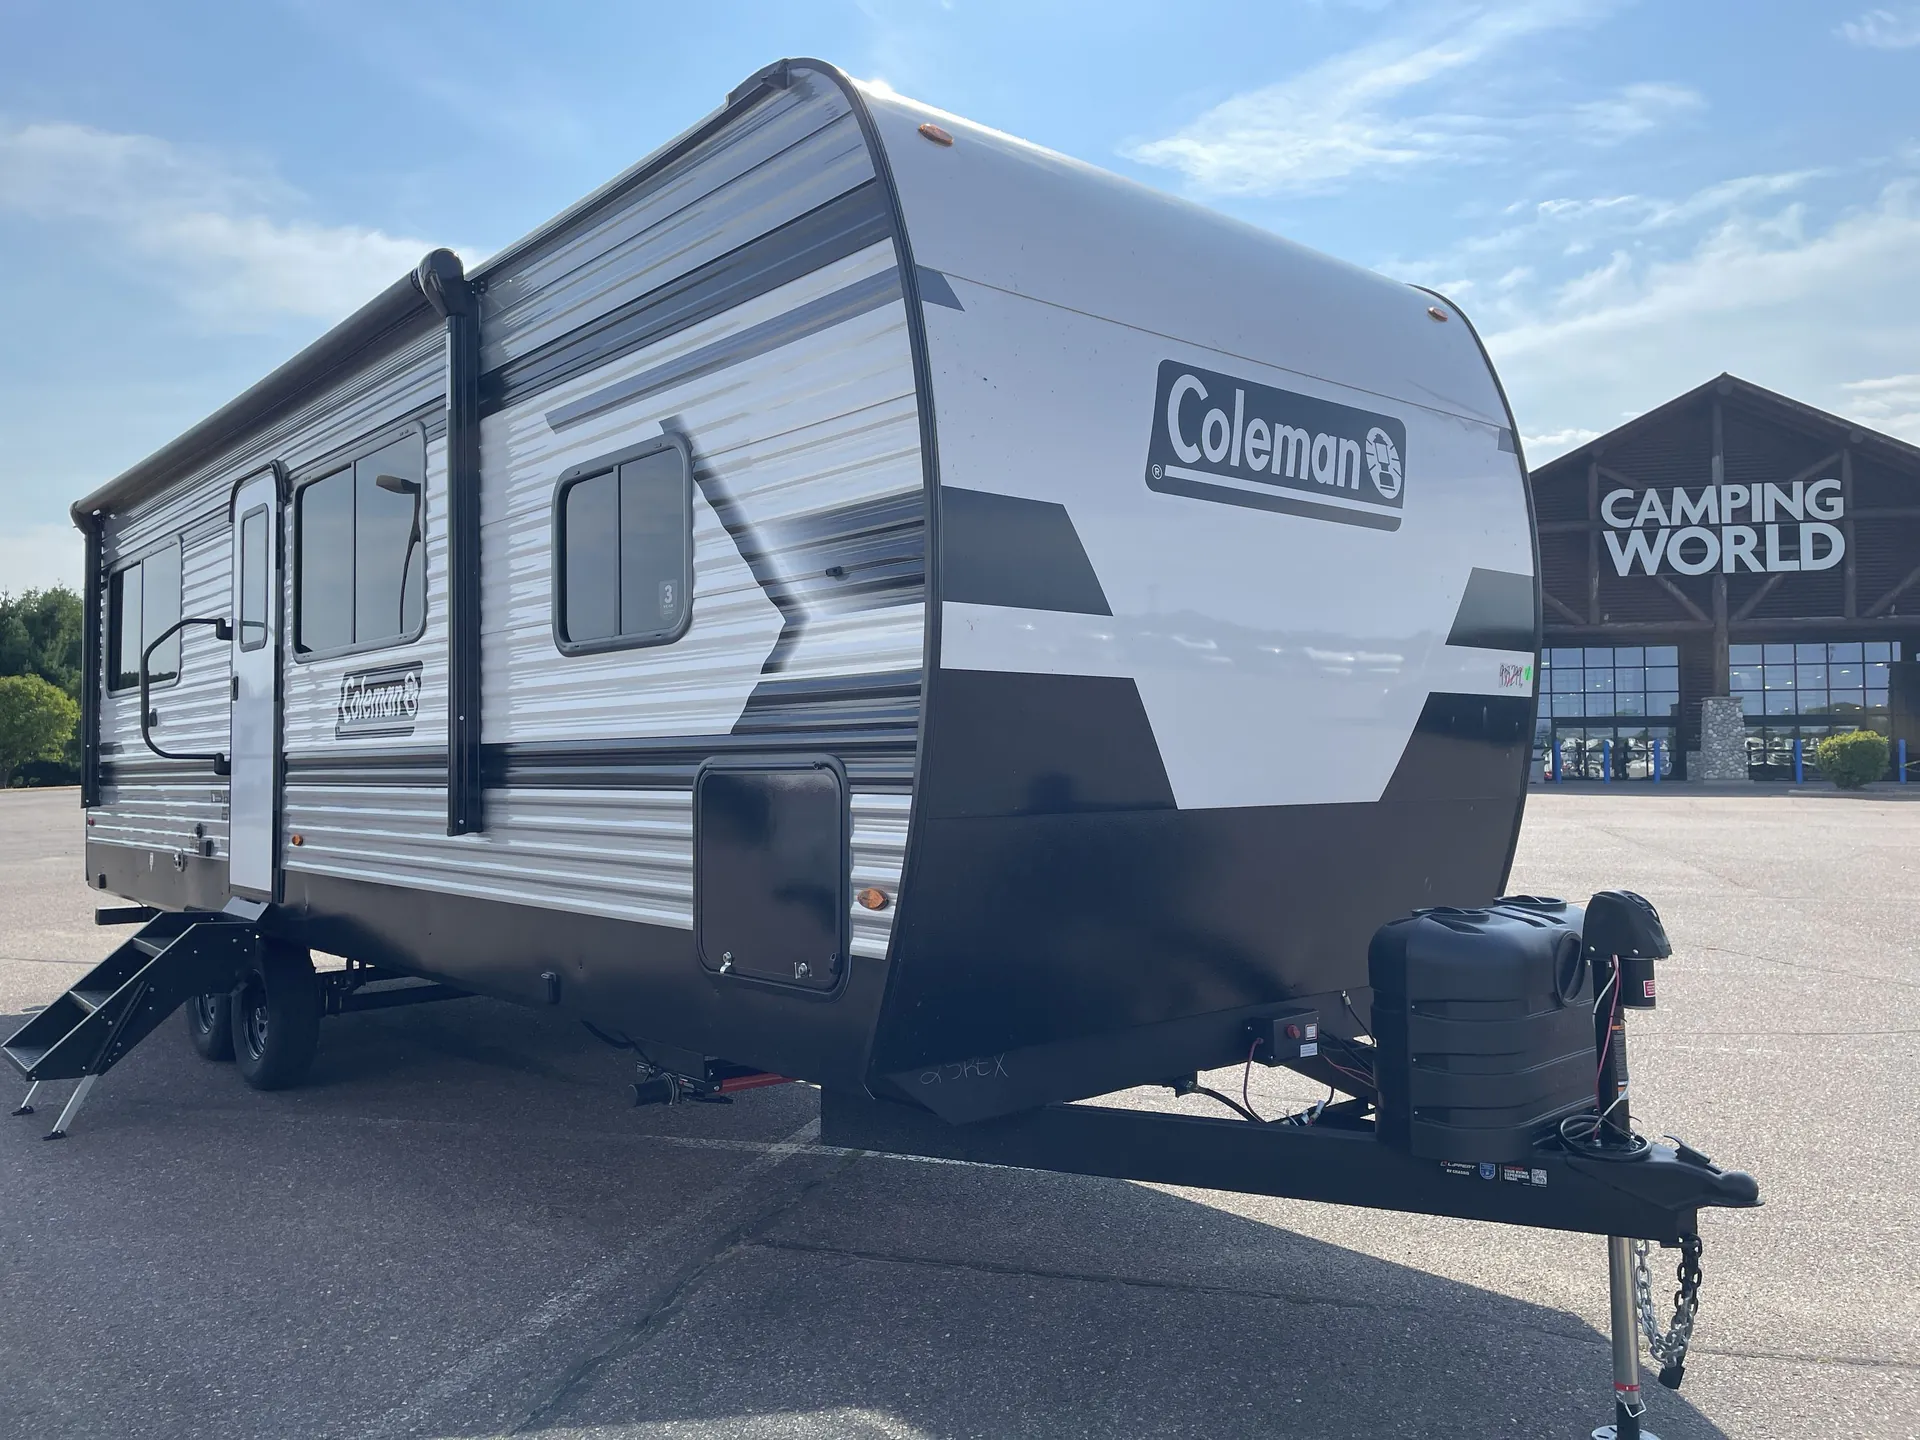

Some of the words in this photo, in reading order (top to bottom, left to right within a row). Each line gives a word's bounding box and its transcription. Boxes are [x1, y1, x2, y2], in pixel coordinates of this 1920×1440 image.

[1167, 374, 1361, 490] Coleman
[1600, 478, 1844, 528] CAMPING
[1602, 522, 1846, 577] WORLD
[664, 584, 673, 603] 3
[342, 675, 404, 724] Coleman
